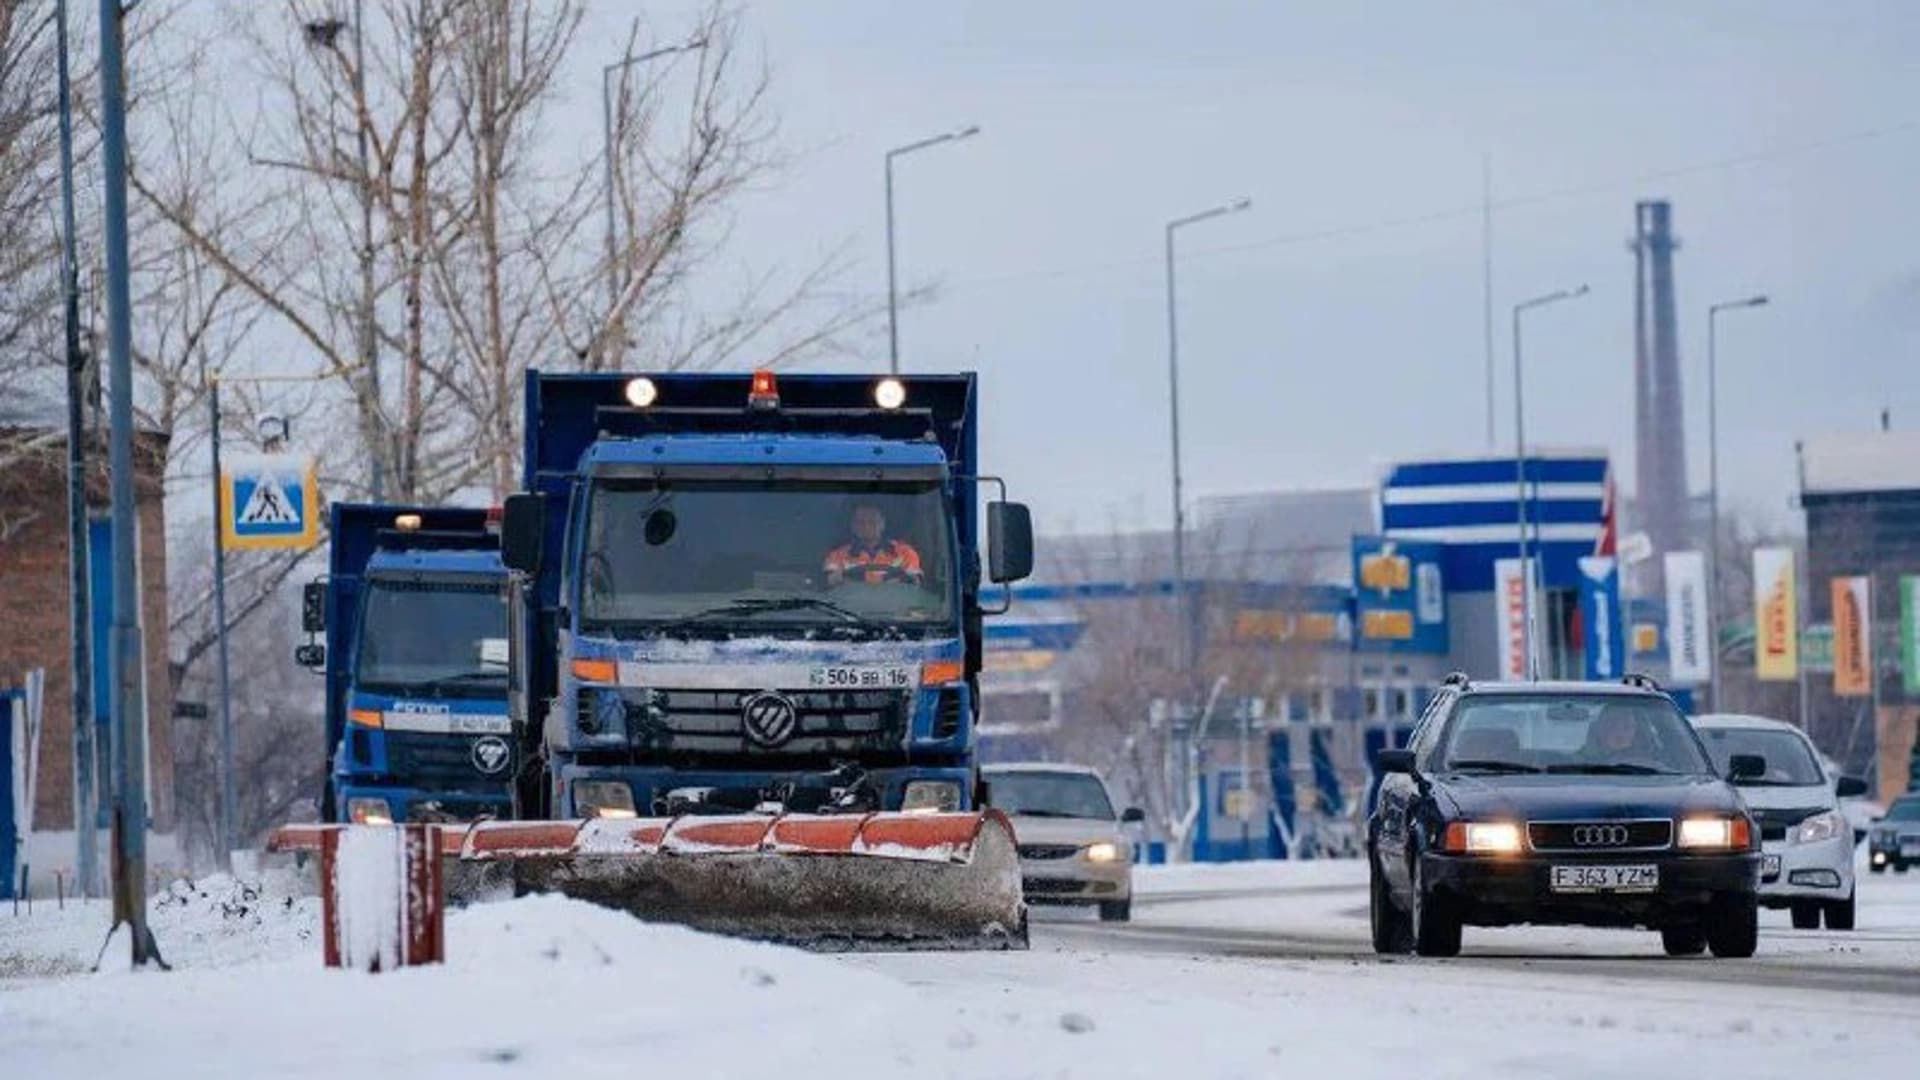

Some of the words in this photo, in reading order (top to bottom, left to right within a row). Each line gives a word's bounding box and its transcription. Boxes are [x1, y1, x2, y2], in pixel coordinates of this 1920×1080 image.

[828, 668, 858, 685] 506
[1556, 867, 1569, 885] F
[1575, 867, 1608, 886] 363
